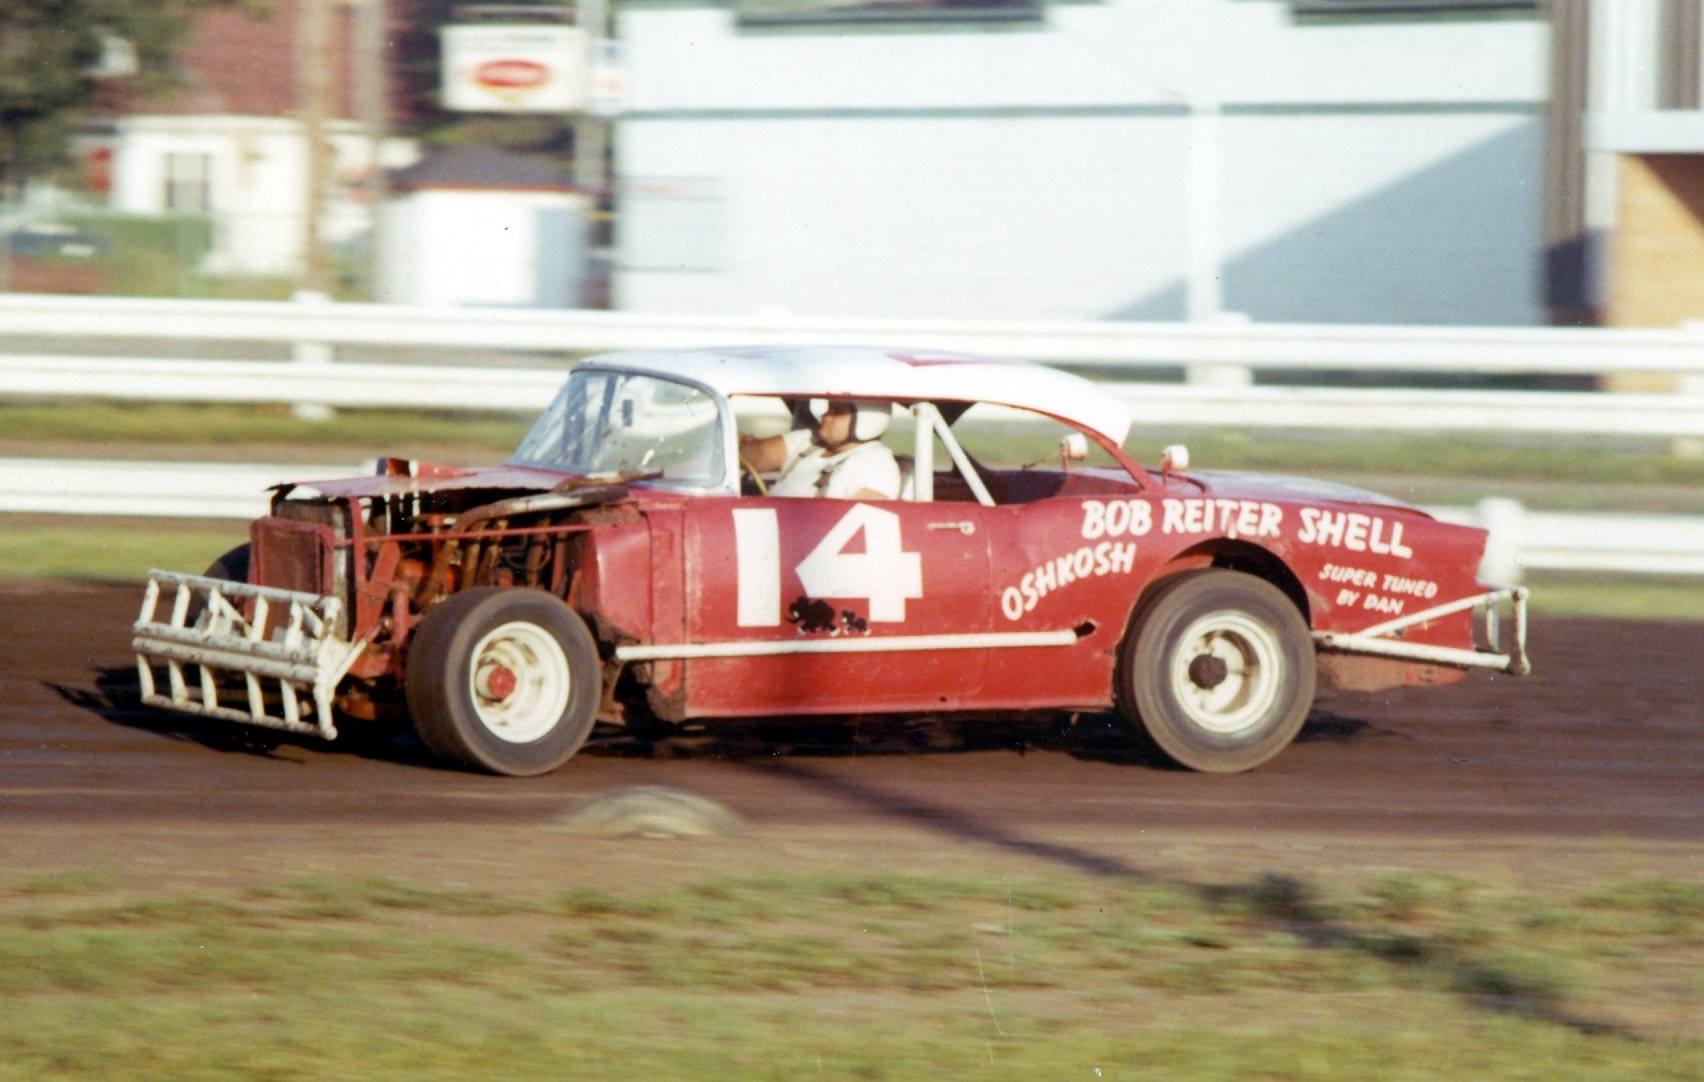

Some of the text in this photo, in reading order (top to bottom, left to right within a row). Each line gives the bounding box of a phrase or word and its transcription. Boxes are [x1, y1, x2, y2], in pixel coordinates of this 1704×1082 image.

[1081, 499, 1413, 560] BOB REITER SHELL
[732, 502, 923, 628] 14
[1001, 541, 1137, 621] OSHKOSH
[1318, 563, 1438, 599] SUPER TUNED
[1336, 588, 1404, 615] BY DAN
